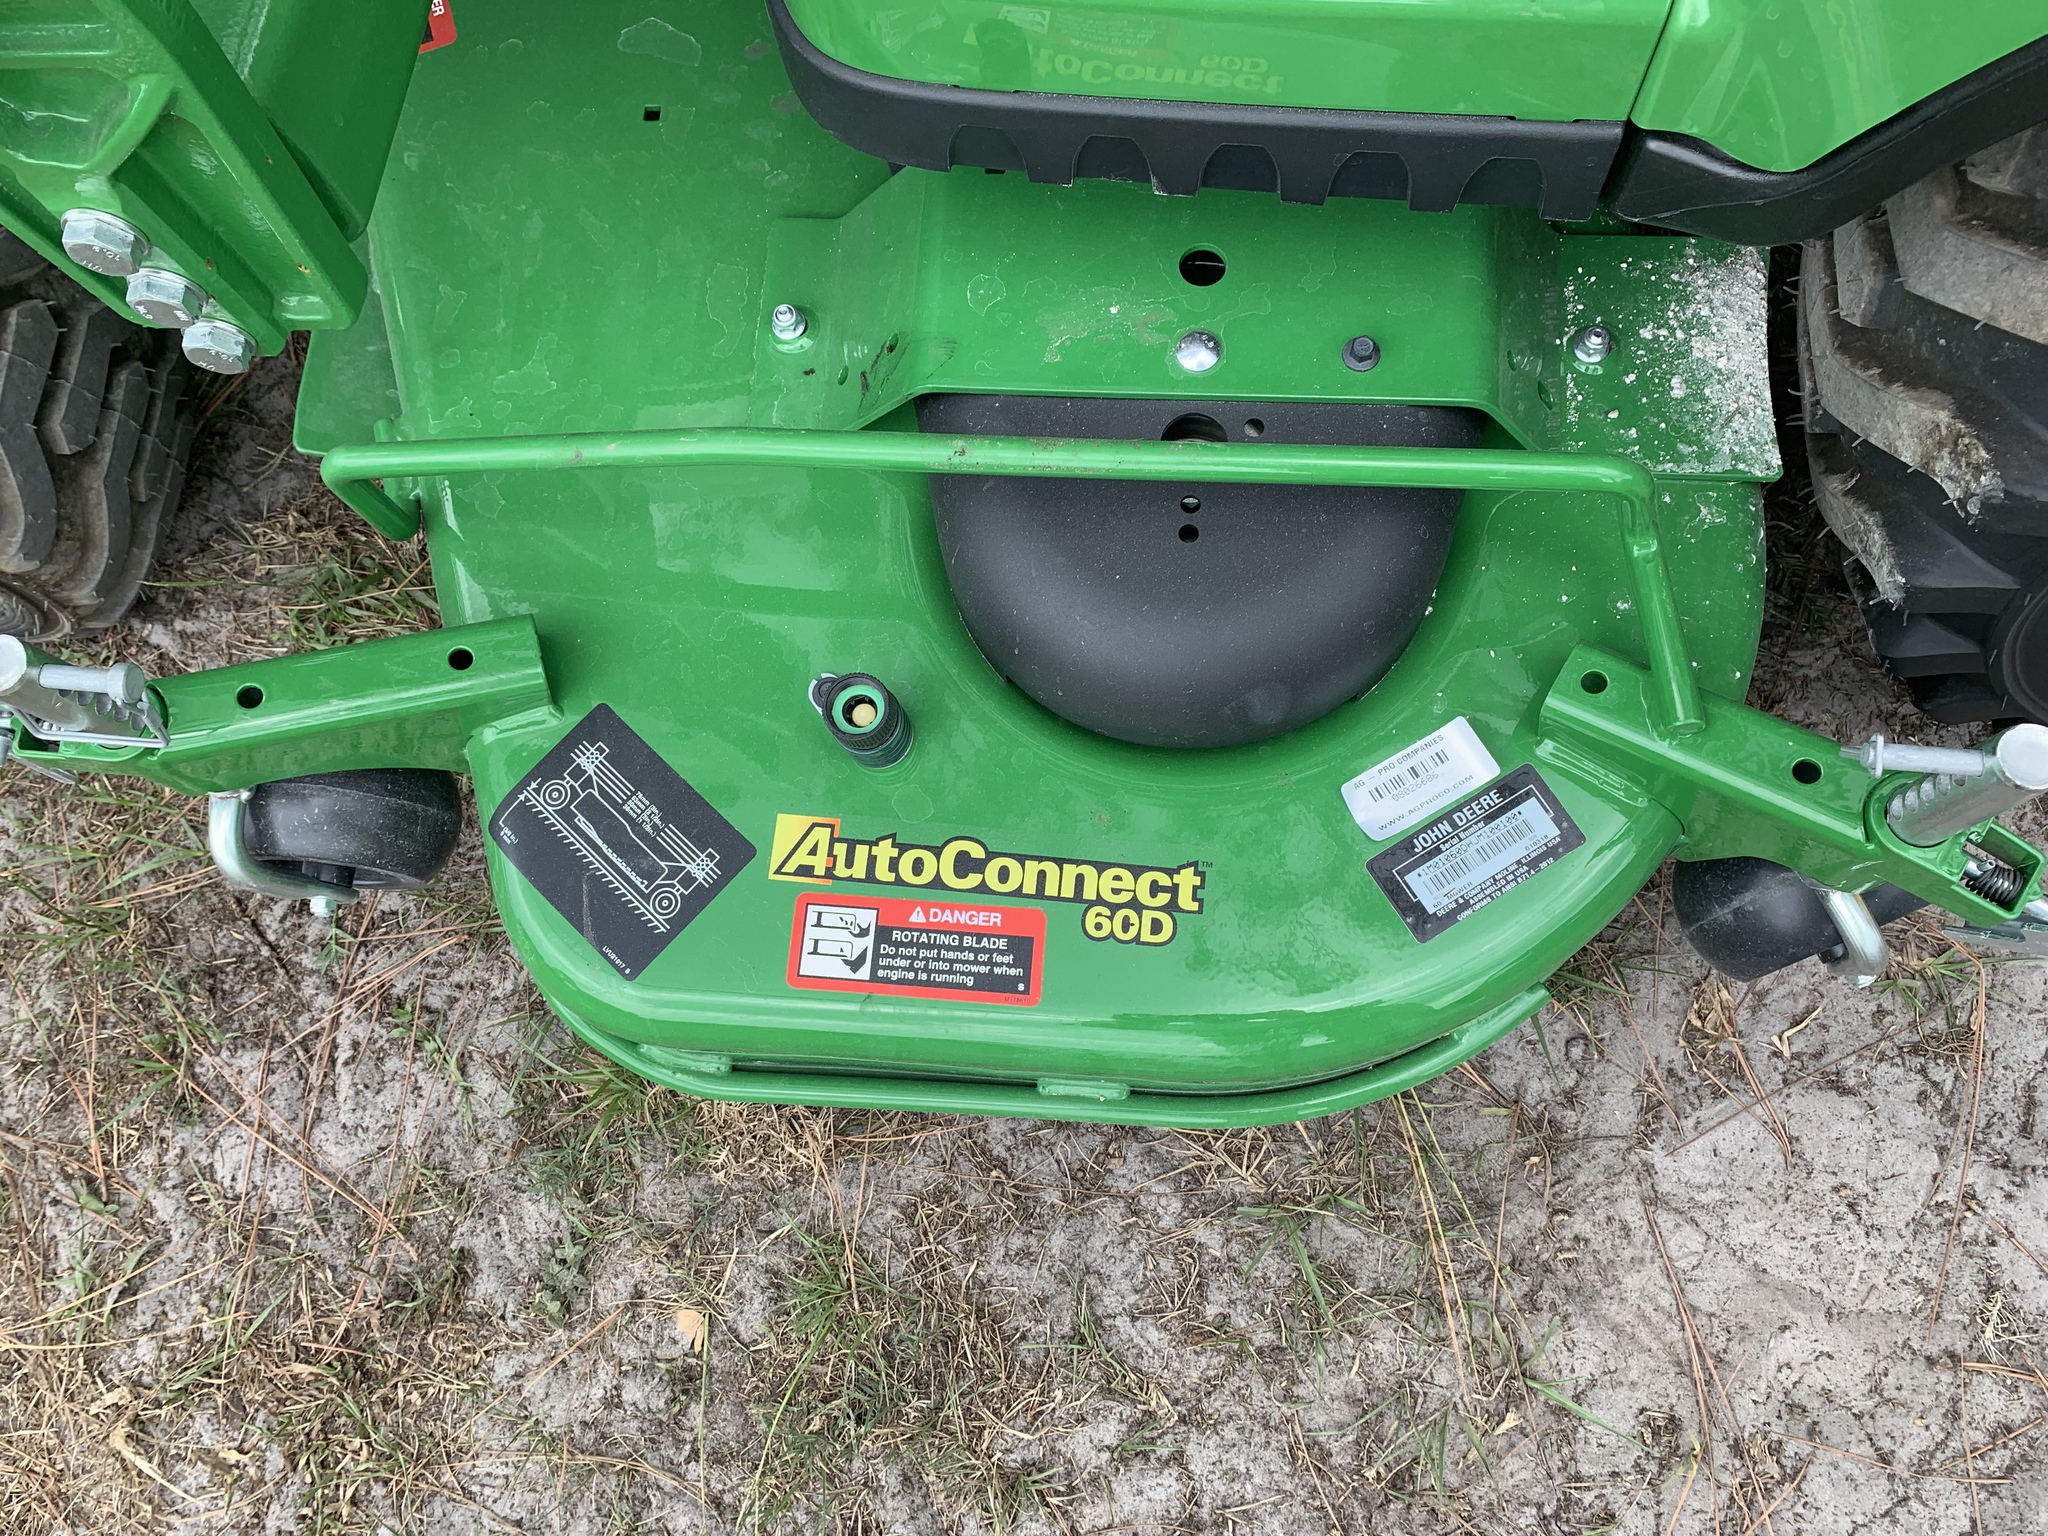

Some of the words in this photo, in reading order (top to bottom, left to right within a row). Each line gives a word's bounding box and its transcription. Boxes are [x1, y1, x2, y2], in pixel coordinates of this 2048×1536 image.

[1353, 780, 1366, 789] AG
[1378, 762, 1395, 776] PRO
[1397, 734, 1444, 764] COMPANIES
[1392, 771, 1439, 802] 08026686
[1412, 820, 1453, 853] JOHN
[1453, 789, 1503, 826] DEERE
[1439, 836, 1459, 851] Serial
[1459, 821, 1485, 839] Number
[1525, 835, 1549, 851] 010318
[778, 822, 1203, 913] AutoConnect
[1436, 900, 1457, 916] DEERE
[1464, 877, 1495, 899] COMPANY
[1520, 845, 1547, 864] ILLINOIS
[1547, 836, 1561, 847] USA
[1468, 878, 1507, 904] ASSEMBLED
[1506, 873, 1515, 881] IN
[1514, 864, 1528, 876] USA
[1456, 896, 1492, 921] CONFORMS
[1492, 890, 1501, 899] TO
[1500, 880, 1517, 893] ANSI
[930, 908, 1001, 926] DANGER
[1083, 904, 1175, 945] 60D
[880, 945, 895, 955] Do
[899, 947, 916, 957] not
[919, 948, 938, 960] put
[941, 946, 975, 961] hands
[977, 952, 989, 961] or
[993, 952, 1013, 964] feet
[892, 931, 959, 946] ROTATING
[963, 936, 1008, 950] BLADE
[877, 969, 915, 981] engine
[918, 970, 928, 980] is
[931, 972, 974, 986] running
[879, 957, 911, 968] under
[914, 960, 926, 969] or
[929, 959, 949, 971] into
[953, 963, 991, 974] mower
[994, 965, 1023, 976] when
